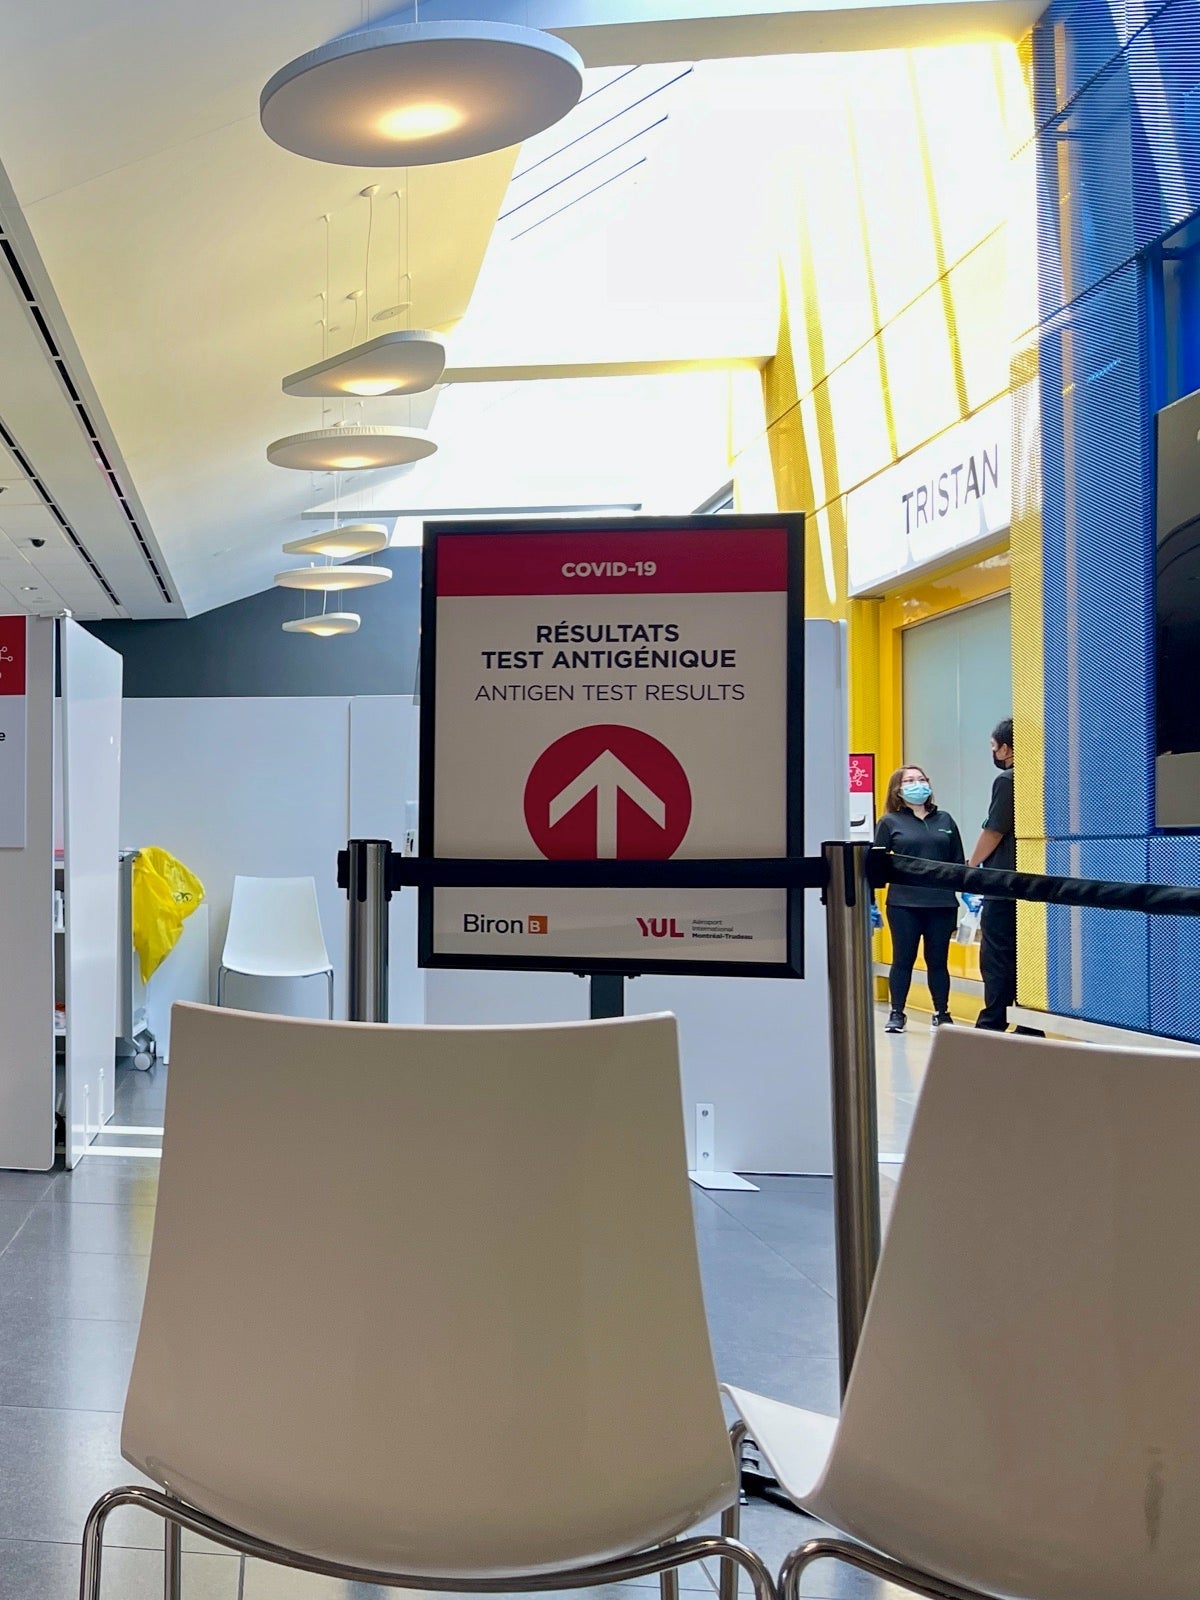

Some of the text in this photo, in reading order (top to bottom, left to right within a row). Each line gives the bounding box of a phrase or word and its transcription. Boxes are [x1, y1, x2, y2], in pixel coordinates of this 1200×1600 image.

[902, 443, 998, 535] TRISTAN
[561, 561, 657, 578] COVID-19
[536, 621, 680, 643] RÉSULTATS
[481, 646, 736, 669] TEST ANTIGÉNIQUE
[474, 684, 746, 701] ANTIGEN TEST RESULTS
[463, 914, 523, 934] Biron
[636, 917, 685, 938] YUL
